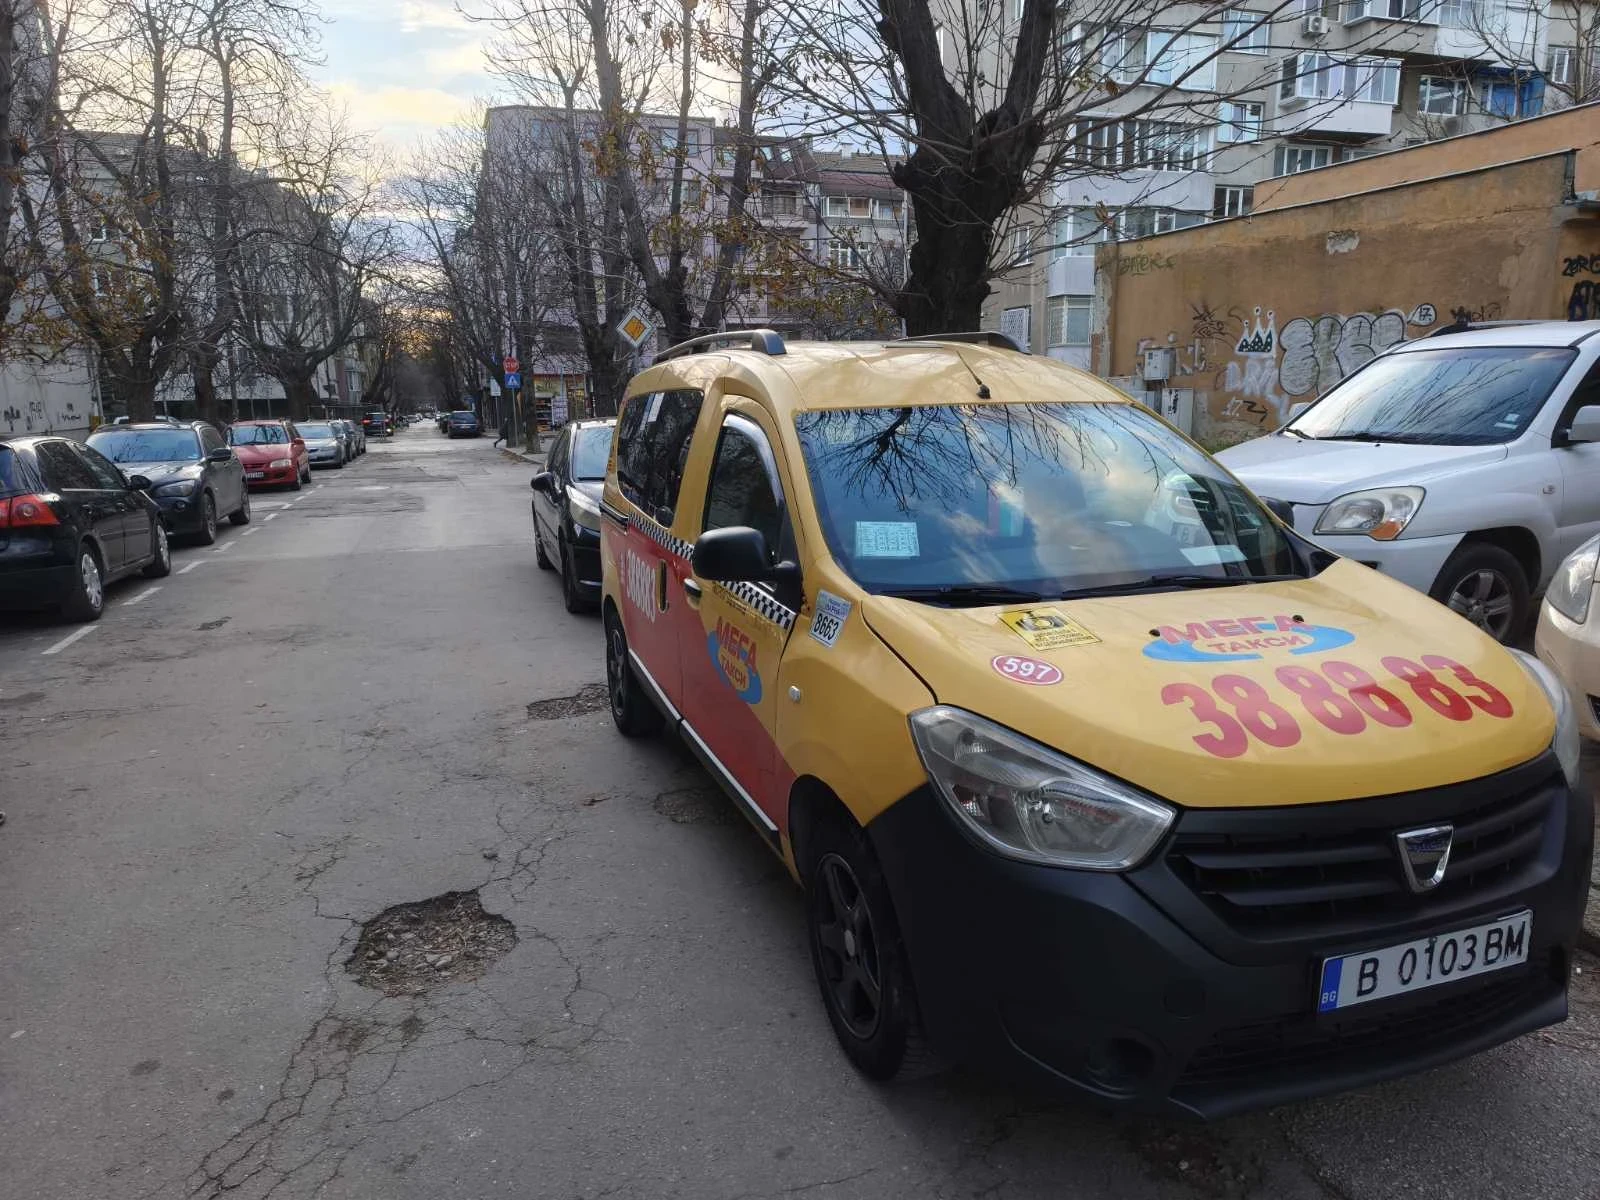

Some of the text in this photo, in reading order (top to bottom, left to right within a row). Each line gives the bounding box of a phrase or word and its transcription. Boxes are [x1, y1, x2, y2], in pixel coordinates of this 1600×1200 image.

[813, 613, 839, 641] 8663
[1158, 614, 1316, 644] МЕГА
[716, 616, 758, 676] МЕГА
[1207, 635, 1306, 653] ТАКСИ
[1002, 658, 1053, 680] 597
[1321, 991, 1336, 1004] BG
